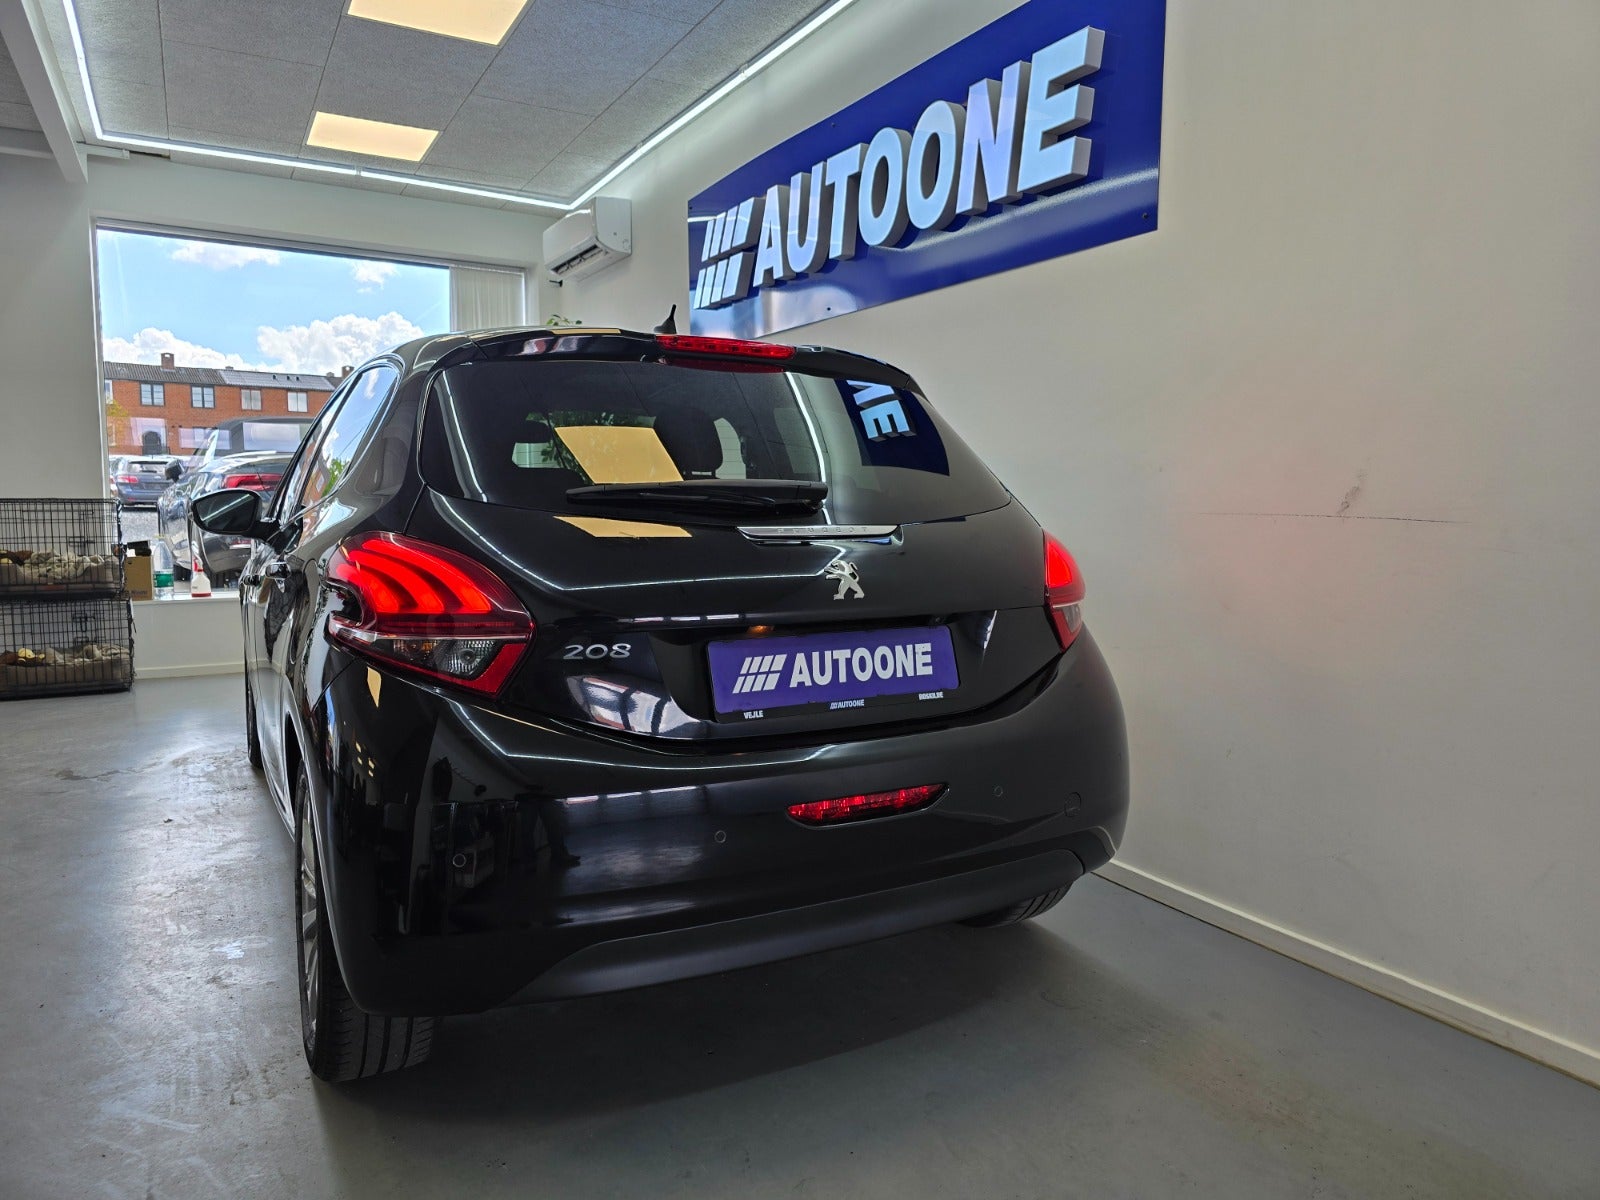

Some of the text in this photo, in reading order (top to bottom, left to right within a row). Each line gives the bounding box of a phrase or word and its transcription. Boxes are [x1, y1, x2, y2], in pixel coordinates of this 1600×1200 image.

[753, 25, 1105, 287] AUTOONE
[563, 643, 632, 659] 208
[789, 643, 933, 688] AUTOONE
[837, 699, 865, 709] AUTOONE
[743, 710, 764, 719] VEJLE
